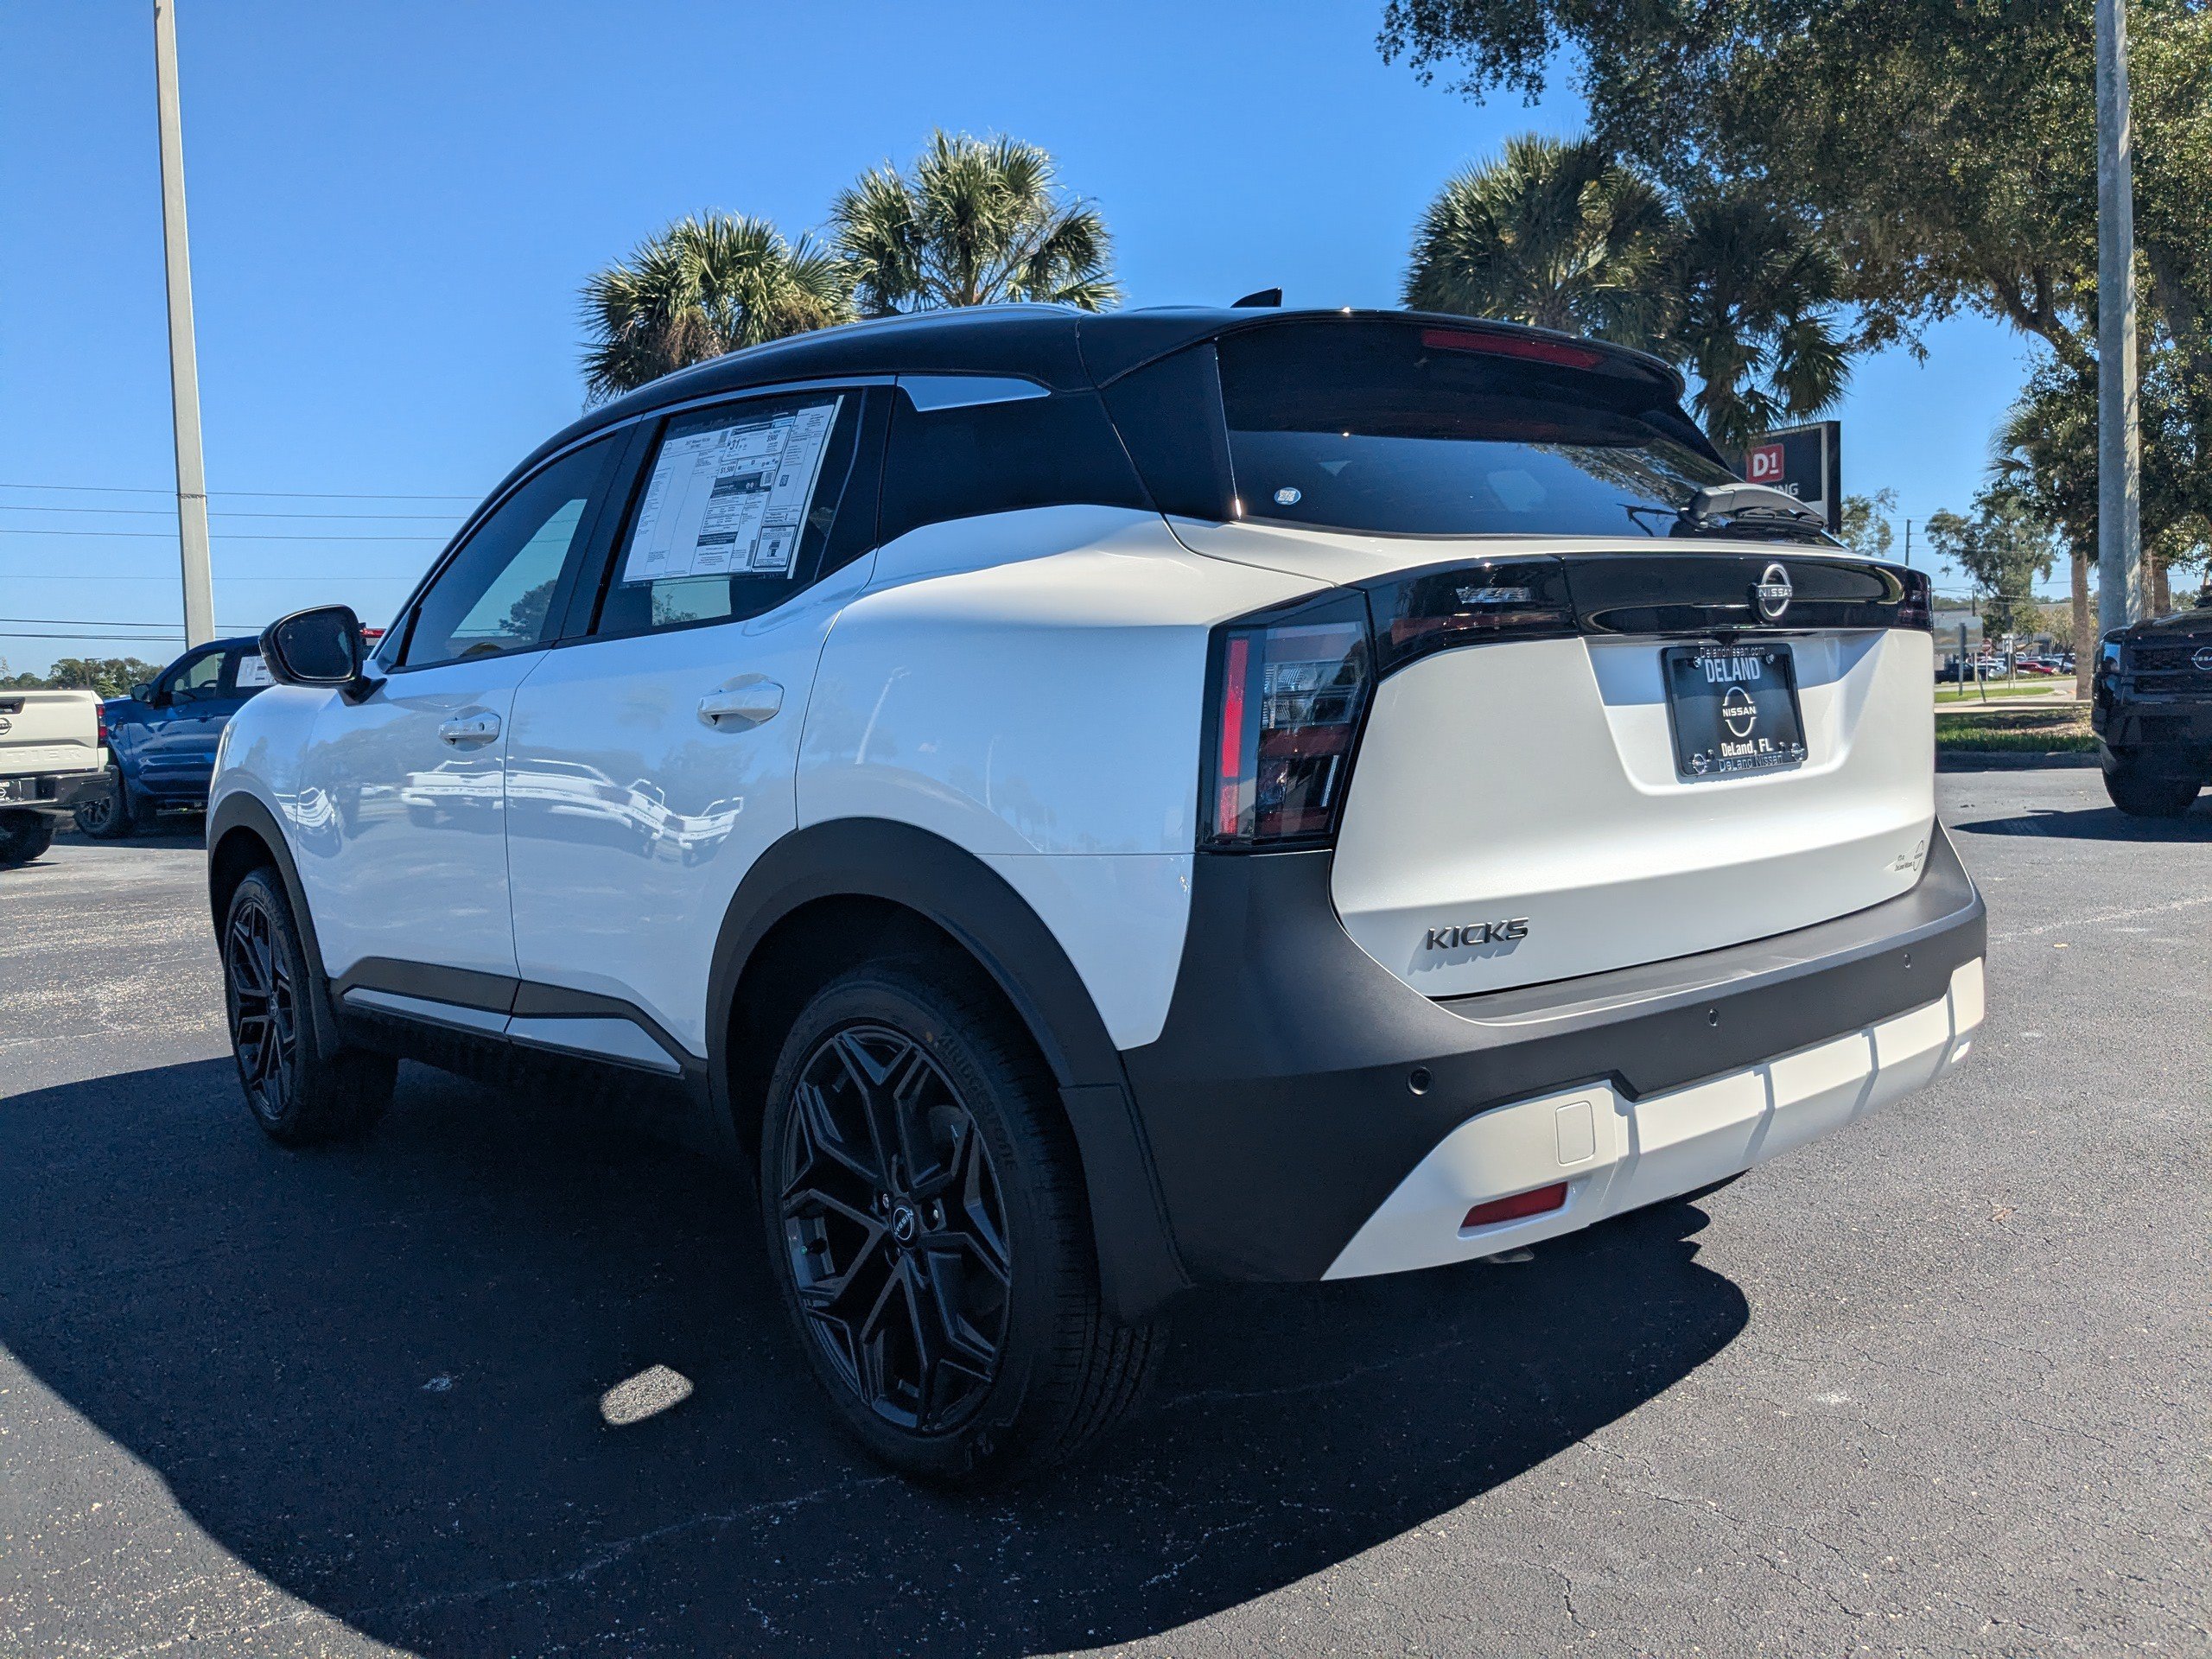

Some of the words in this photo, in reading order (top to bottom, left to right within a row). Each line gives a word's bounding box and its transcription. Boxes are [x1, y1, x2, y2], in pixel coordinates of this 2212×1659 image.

[1752, 452, 1779, 477] D1
[1704, 657, 1761, 683] DELAND
[1722, 705, 1758, 717] NISSAN
[1720, 740, 1758, 757] DeLand,
[1758, 738, 1775, 753] FL
[1427, 917, 1529, 950] KICKS
[893, 1209, 914, 1236] NISSAN
